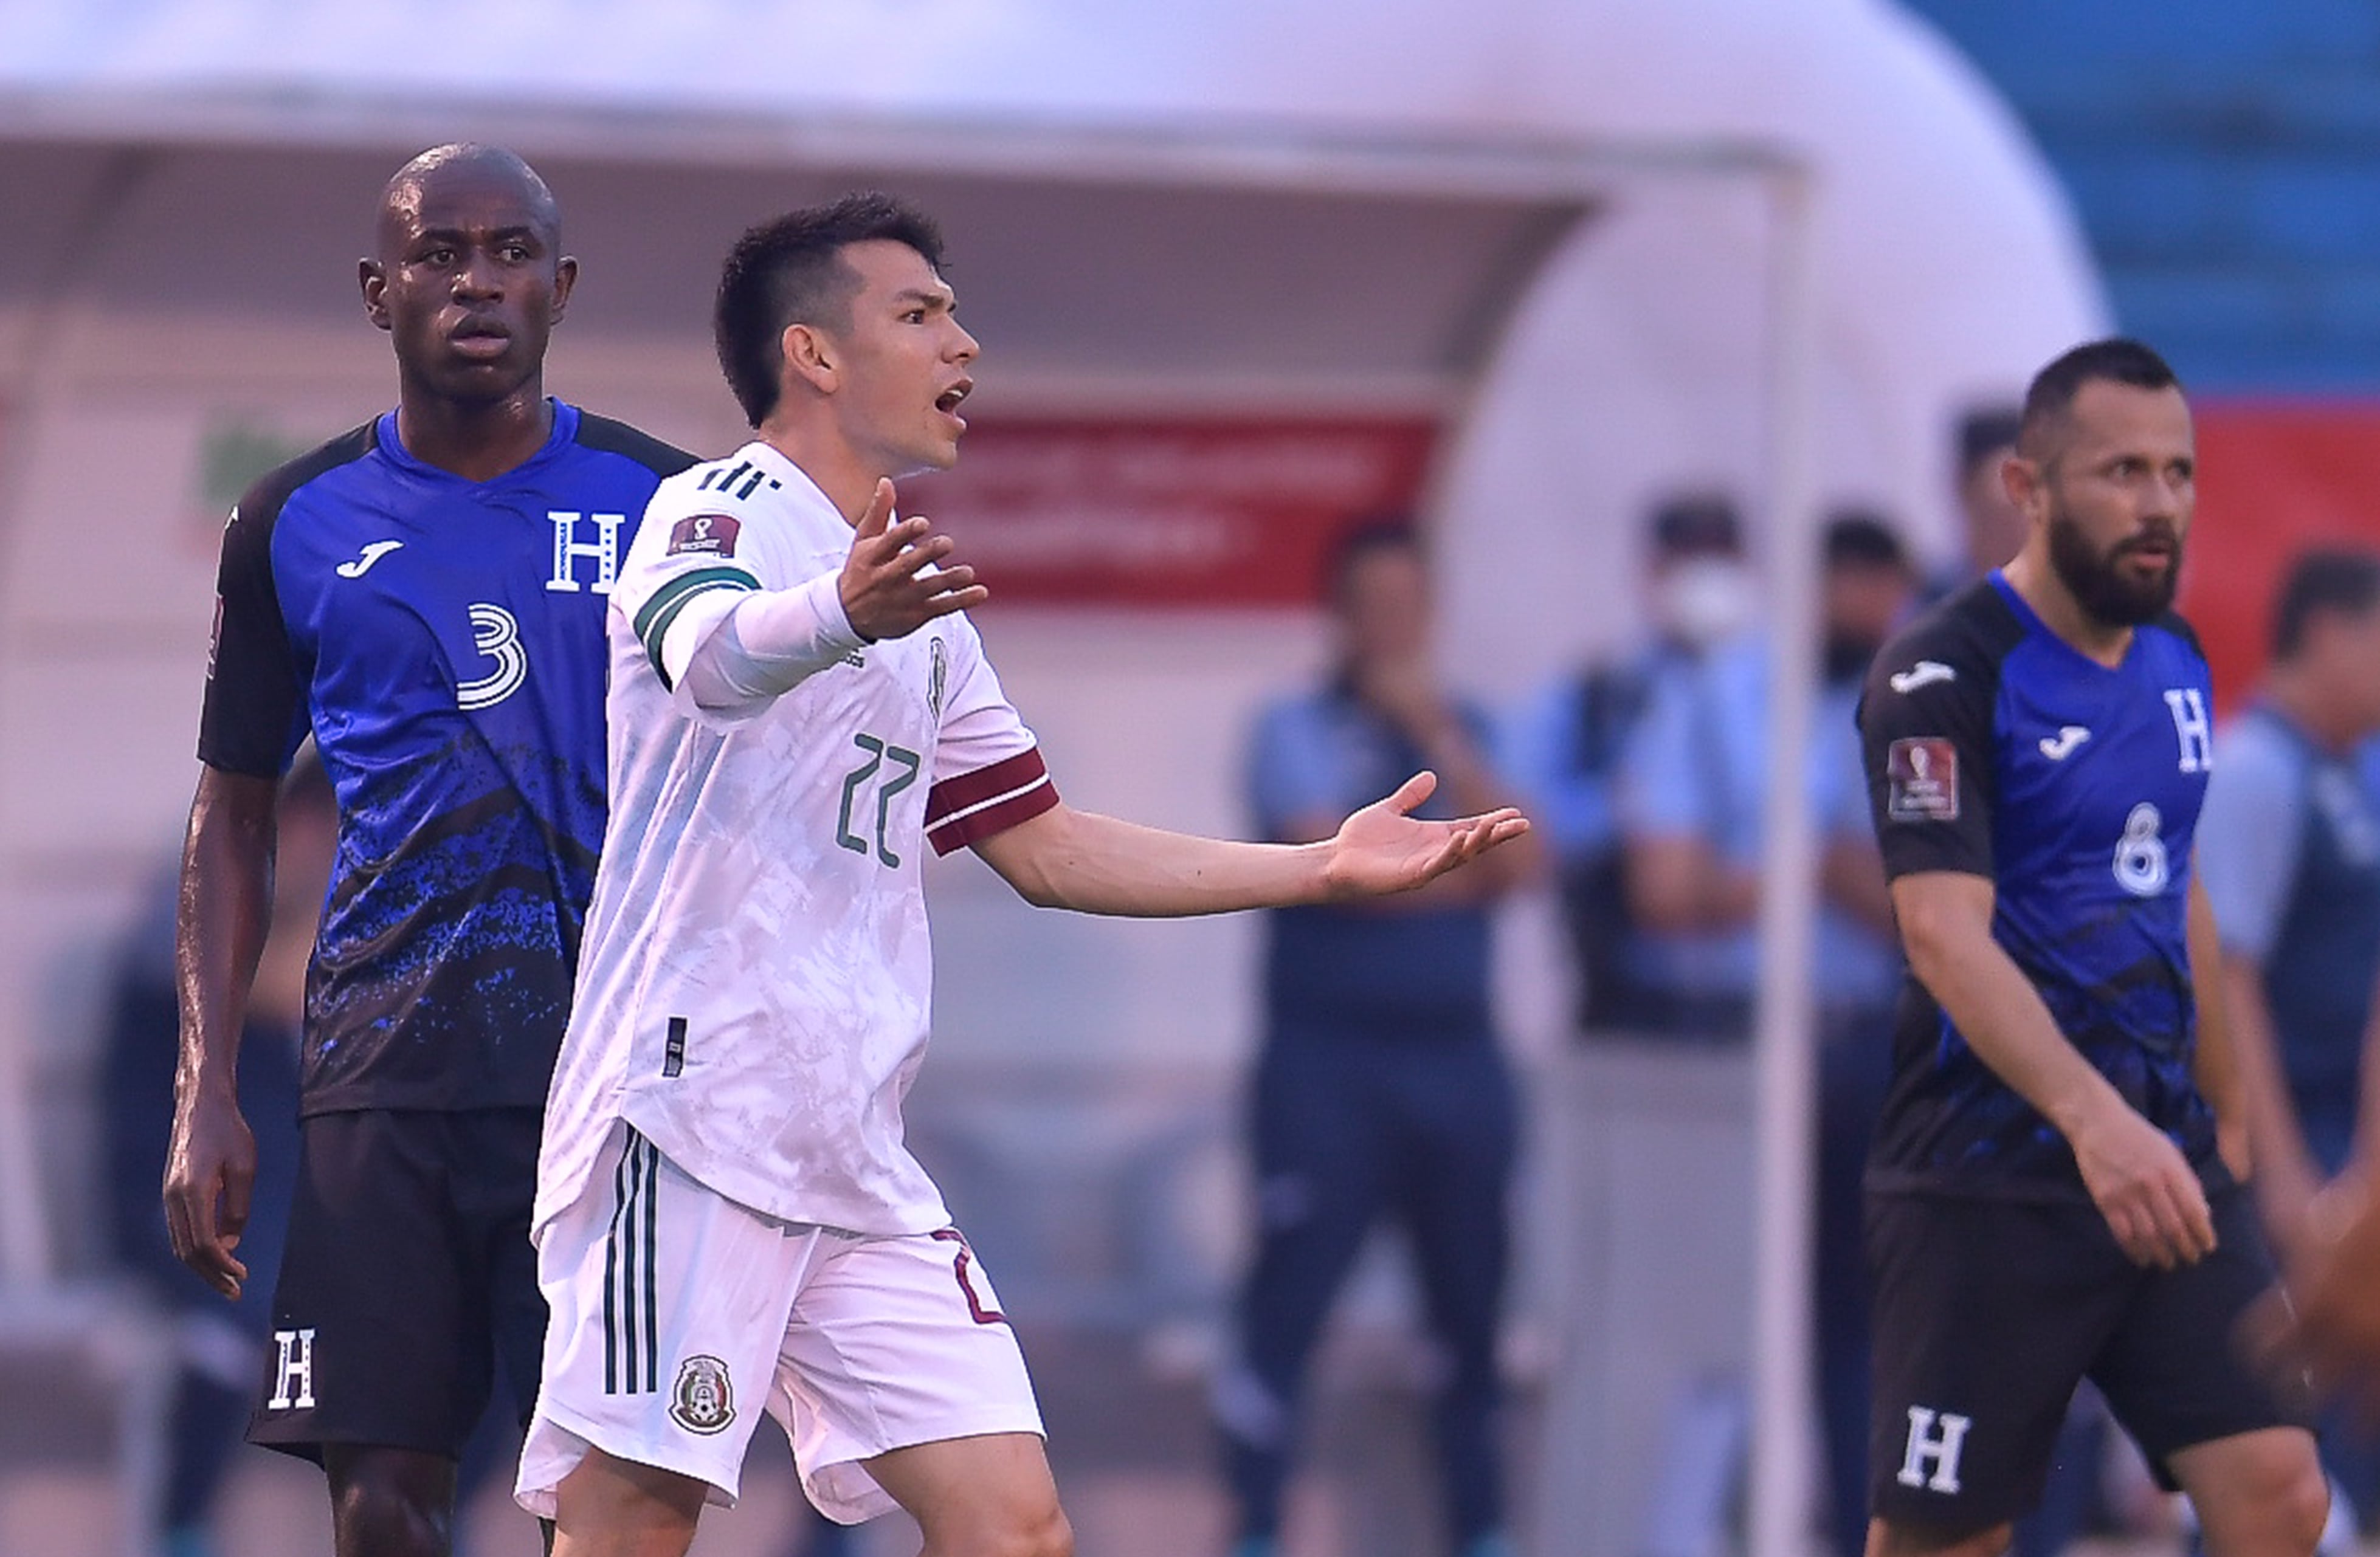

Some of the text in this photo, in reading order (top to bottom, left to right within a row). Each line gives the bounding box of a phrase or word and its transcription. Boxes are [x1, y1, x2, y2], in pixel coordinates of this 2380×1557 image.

[457, 603, 526, 710] 3
[2164, 687, 2212, 772] H
[836, 734, 920, 868] 22
[2113, 802, 2170, 896] 8
[269, 1328, 315, 1409] H
[1897, 1405, 1971, 1494] H
